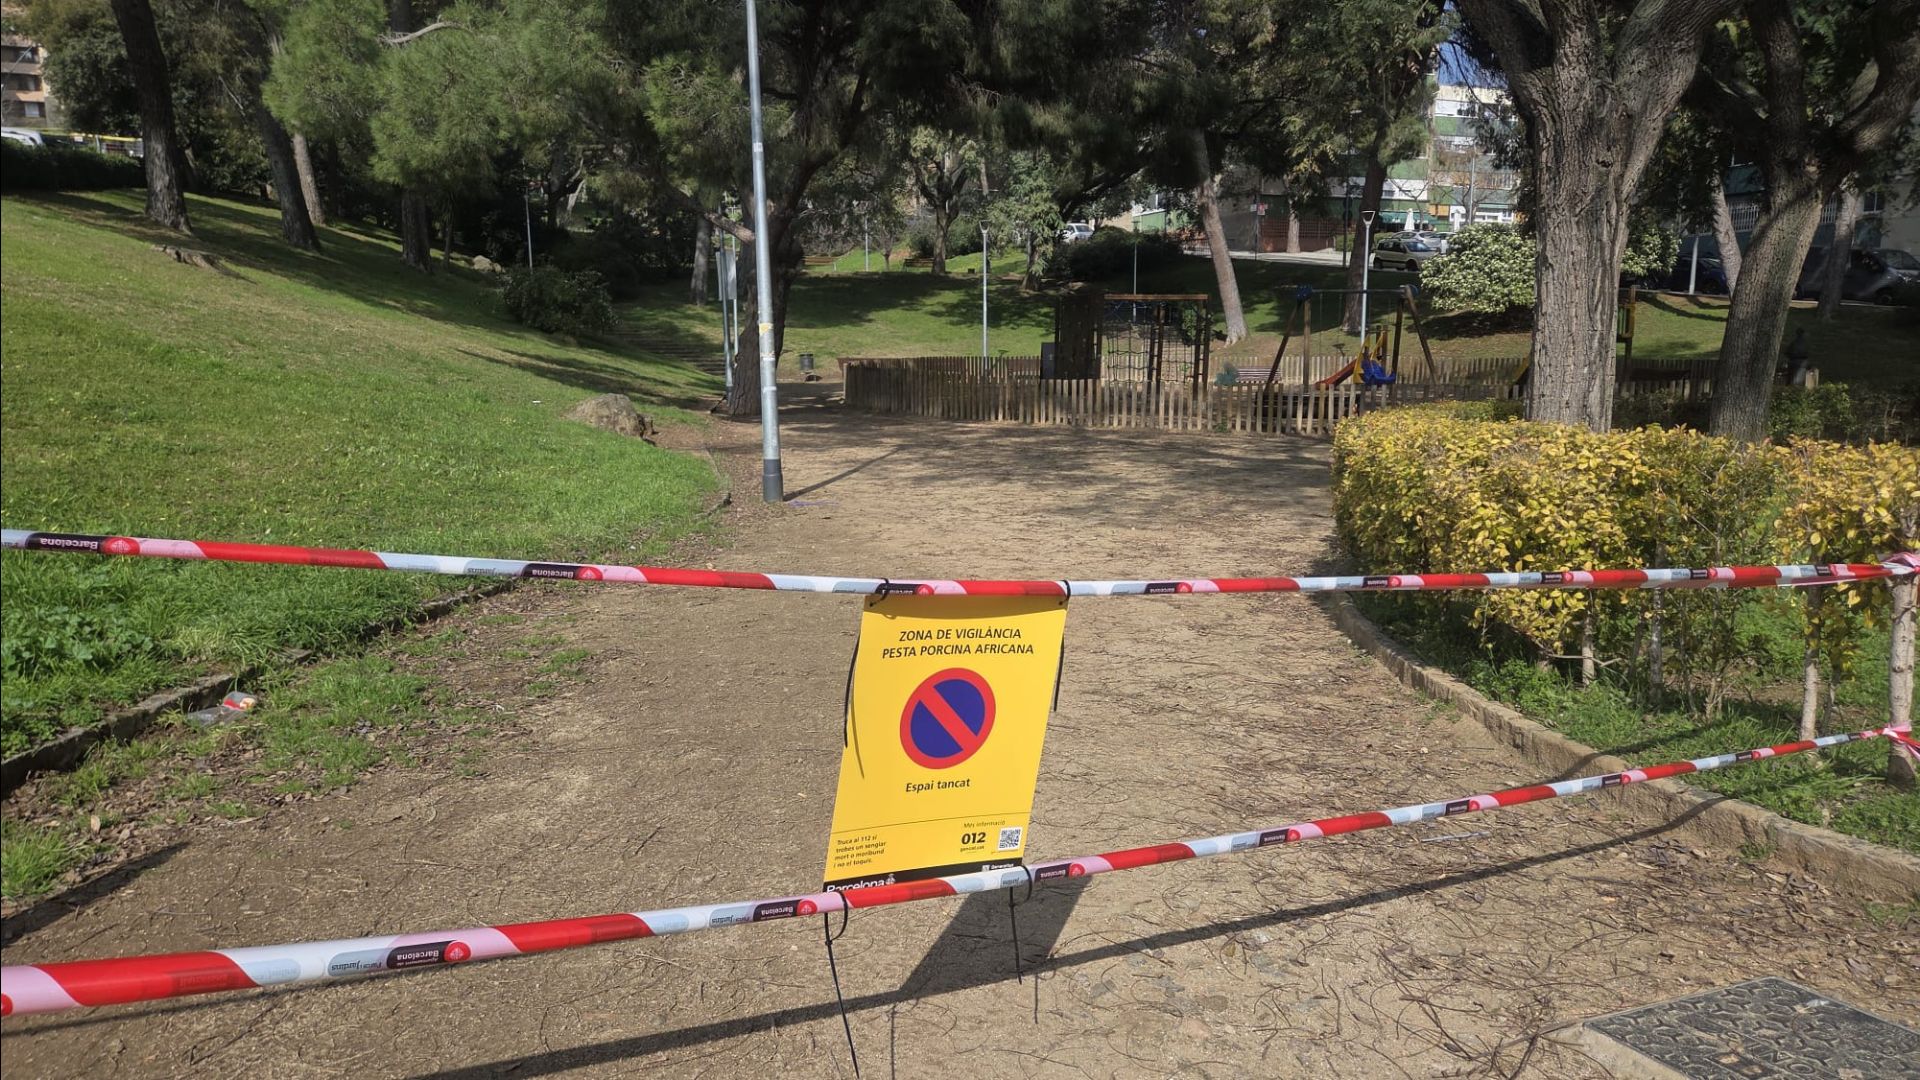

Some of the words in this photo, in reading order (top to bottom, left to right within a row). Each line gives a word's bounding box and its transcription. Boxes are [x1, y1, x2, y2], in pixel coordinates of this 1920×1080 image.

[39, 537, 99, 550] Barcelona
[531, 568, 574, 578] Barcelona
[899, 629, 933, 642] ZONA
[936, 628, 952, 640] DE
[955, 625, 1022, 640] VIGILÀNCIA
[882, 647, 917, 659] PESTA
[920, 644, 971, 656] PORCINA
[974, 643, 1034, 655] AFRICANA
[905, 780, 934, 794] Espai
[937, 778, 970, 789] tancat
[961, 831, 986, 845] 012
[865, 841, 886, 849] senglar
[826, 880, 885, 893] Barcelona
[761, 906, 794, 916] Barcelona
[396, 949, 439, 960] Barcelona
[331, 960, 360, 971] Jardins
